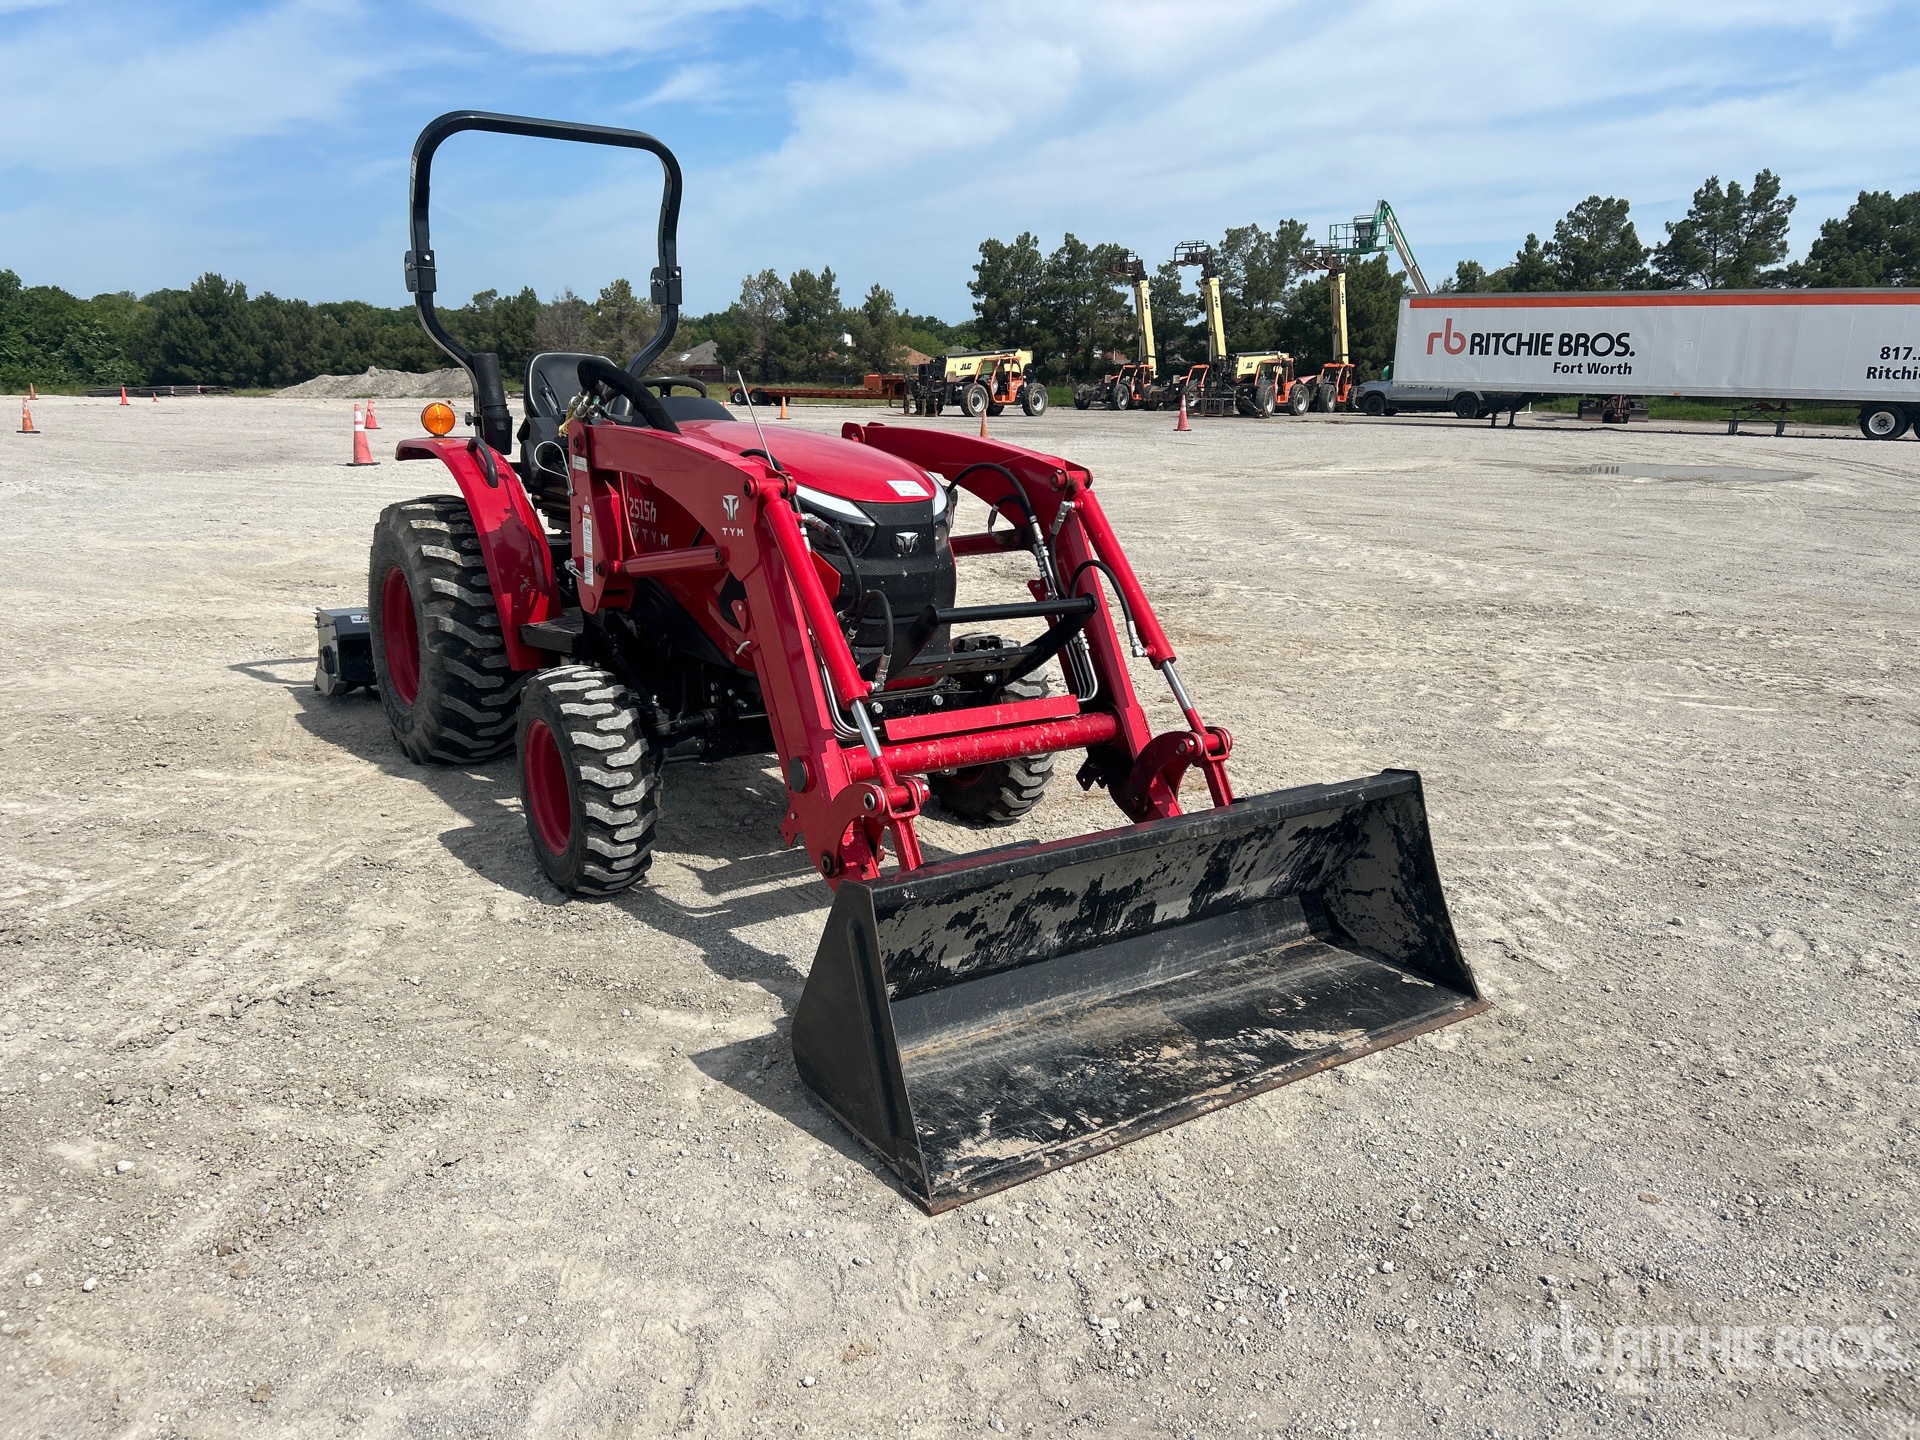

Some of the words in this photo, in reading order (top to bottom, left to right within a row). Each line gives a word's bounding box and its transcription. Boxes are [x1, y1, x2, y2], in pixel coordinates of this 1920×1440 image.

[1426, 318, 1467, 356] rb
[1469, 332, 1554, 356] RITCHIE
[1558, 332, 1636, 357] BROS.
[1879, 346, 1920, 361] 817.
[960, 362, 972, 371] JLG
[1553, 361, 1584, 375] Fort
[1587, 361, 1633, 375] Worth
[1866, 365, 1920, 380] Ritchi
[641, 528, 669, 547] TYM
[721, 527, 744, 537] TYM
